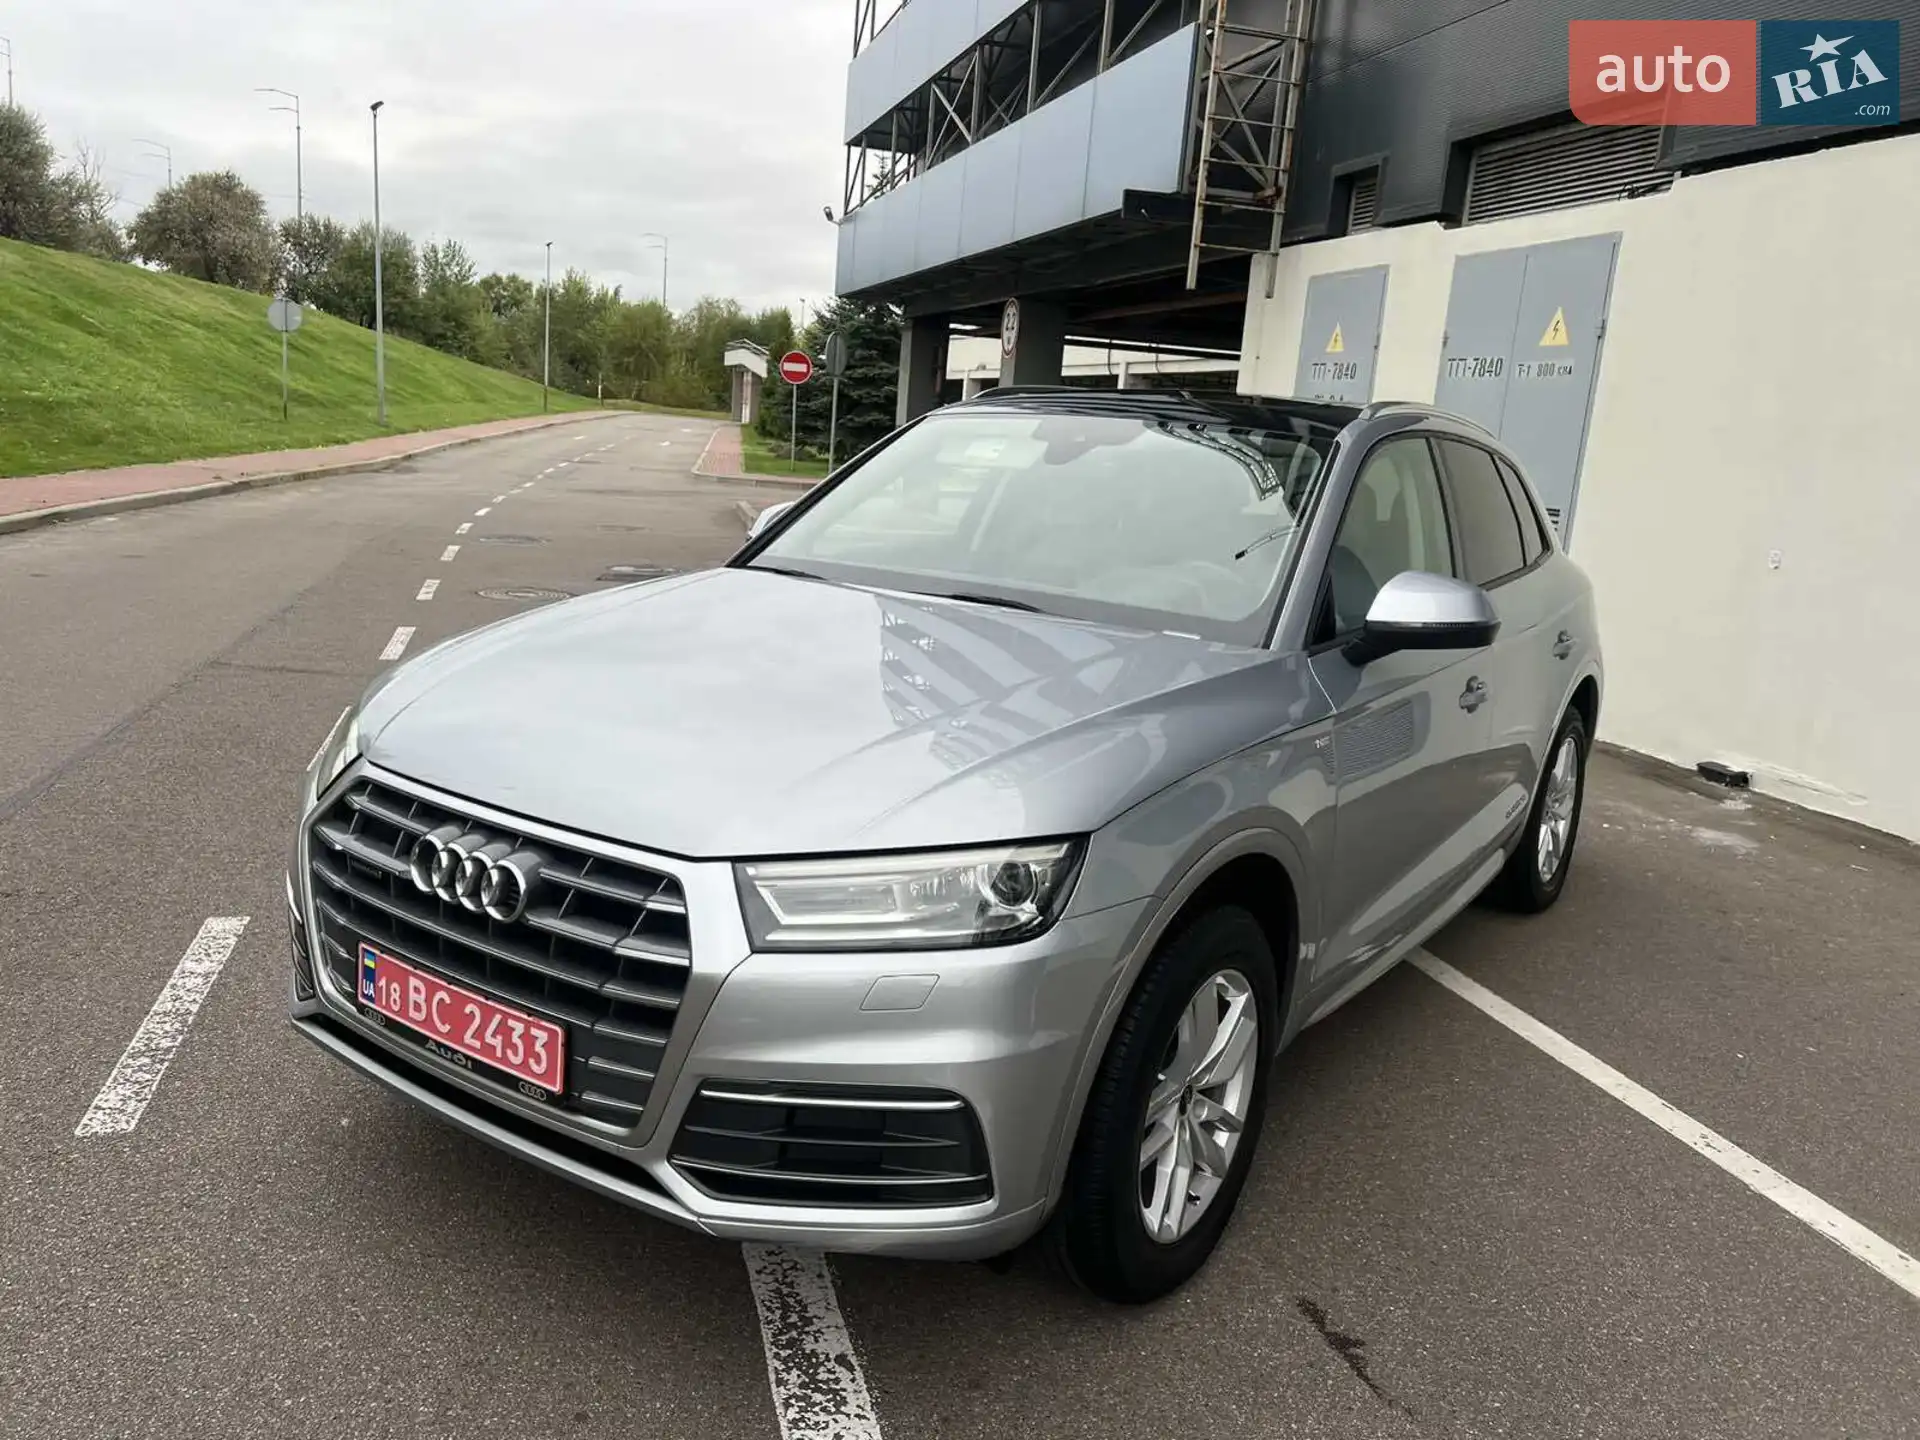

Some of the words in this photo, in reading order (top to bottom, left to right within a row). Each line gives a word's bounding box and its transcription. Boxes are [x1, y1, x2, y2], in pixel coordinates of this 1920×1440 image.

[362, 980, 375, 998] UA
[378, 976, 401, 1012] 18
[408, 976, 451, 1034] BC
[463, 1003, 549, 1075] 2433
